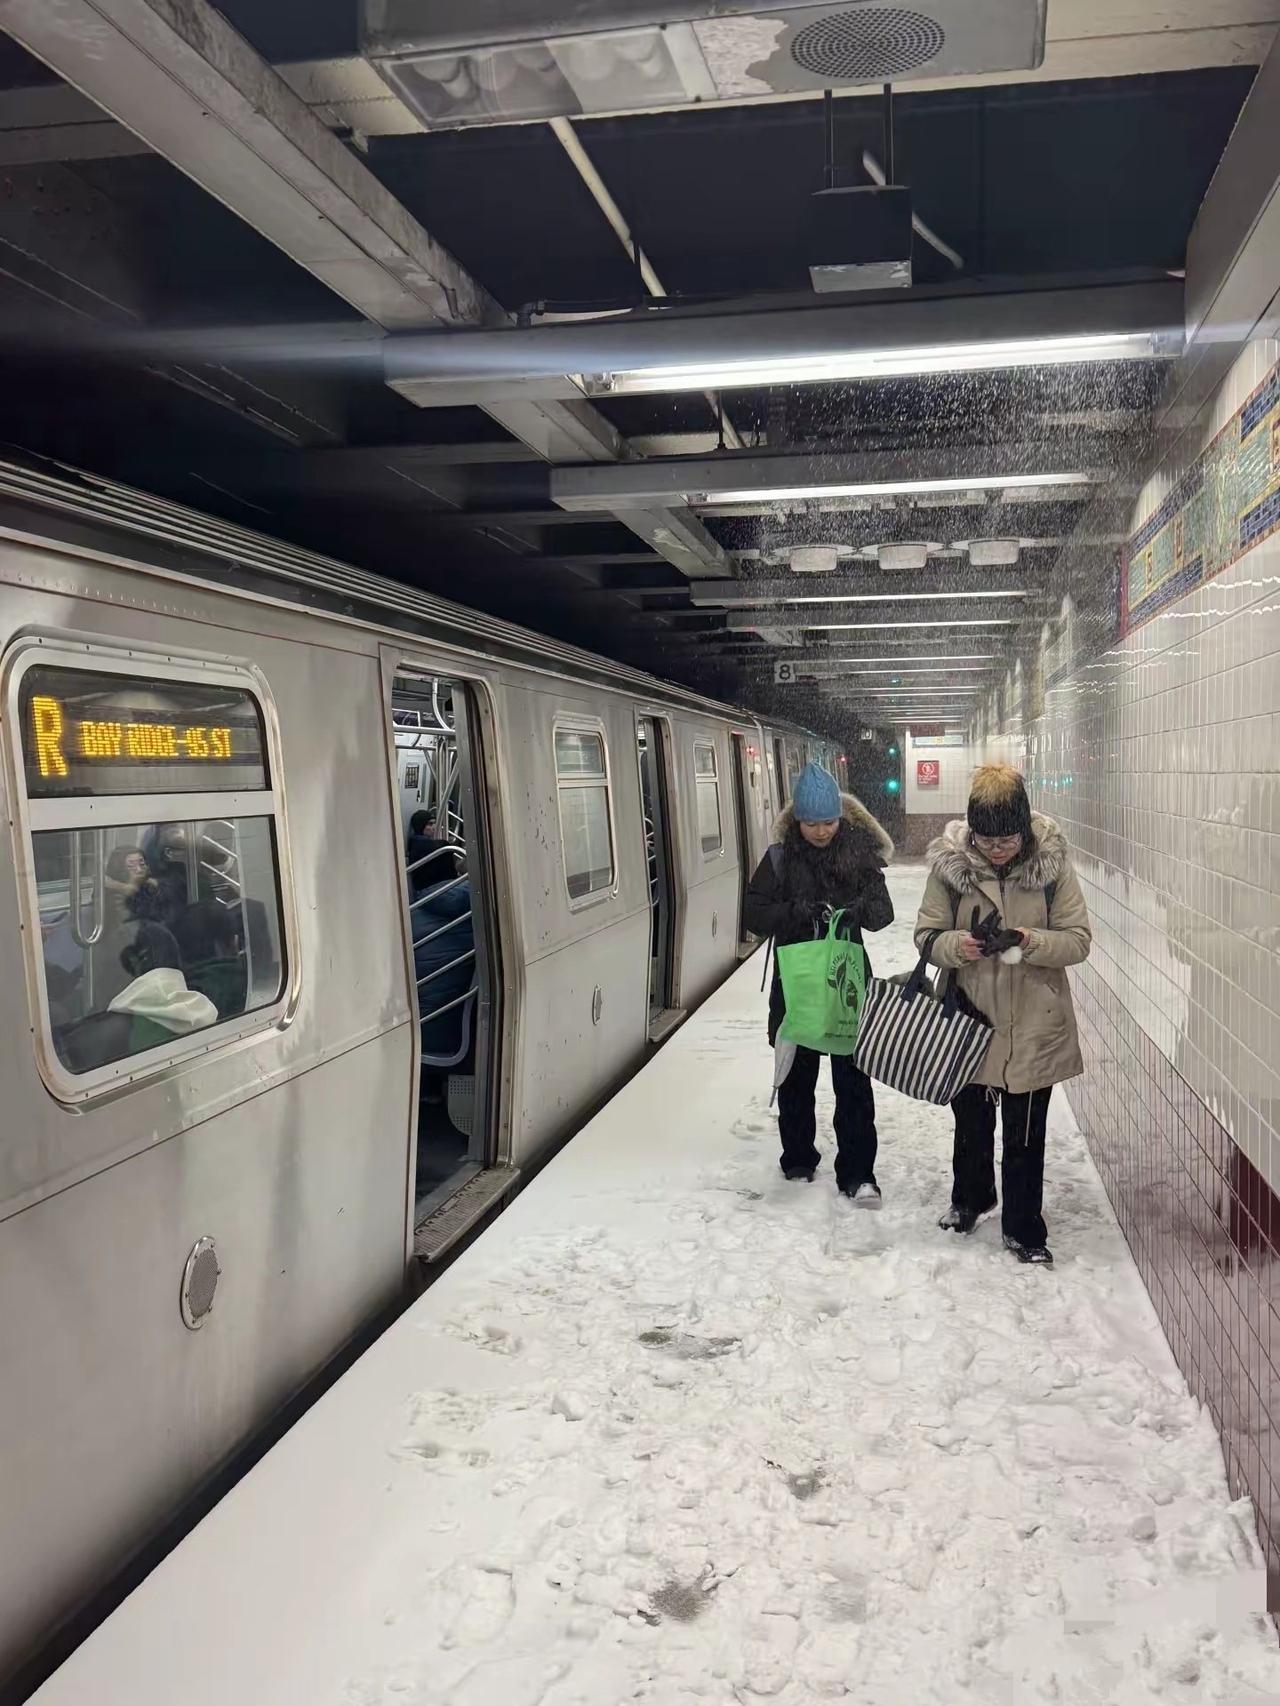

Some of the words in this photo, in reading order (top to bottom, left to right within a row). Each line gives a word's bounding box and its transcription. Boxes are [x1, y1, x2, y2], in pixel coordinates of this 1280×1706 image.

[779, 664, 791, 680] 8
[32, 695, 68, 777] R
[81, 720, 121, 757] BAY
[210, 728, 232, 757] ST
